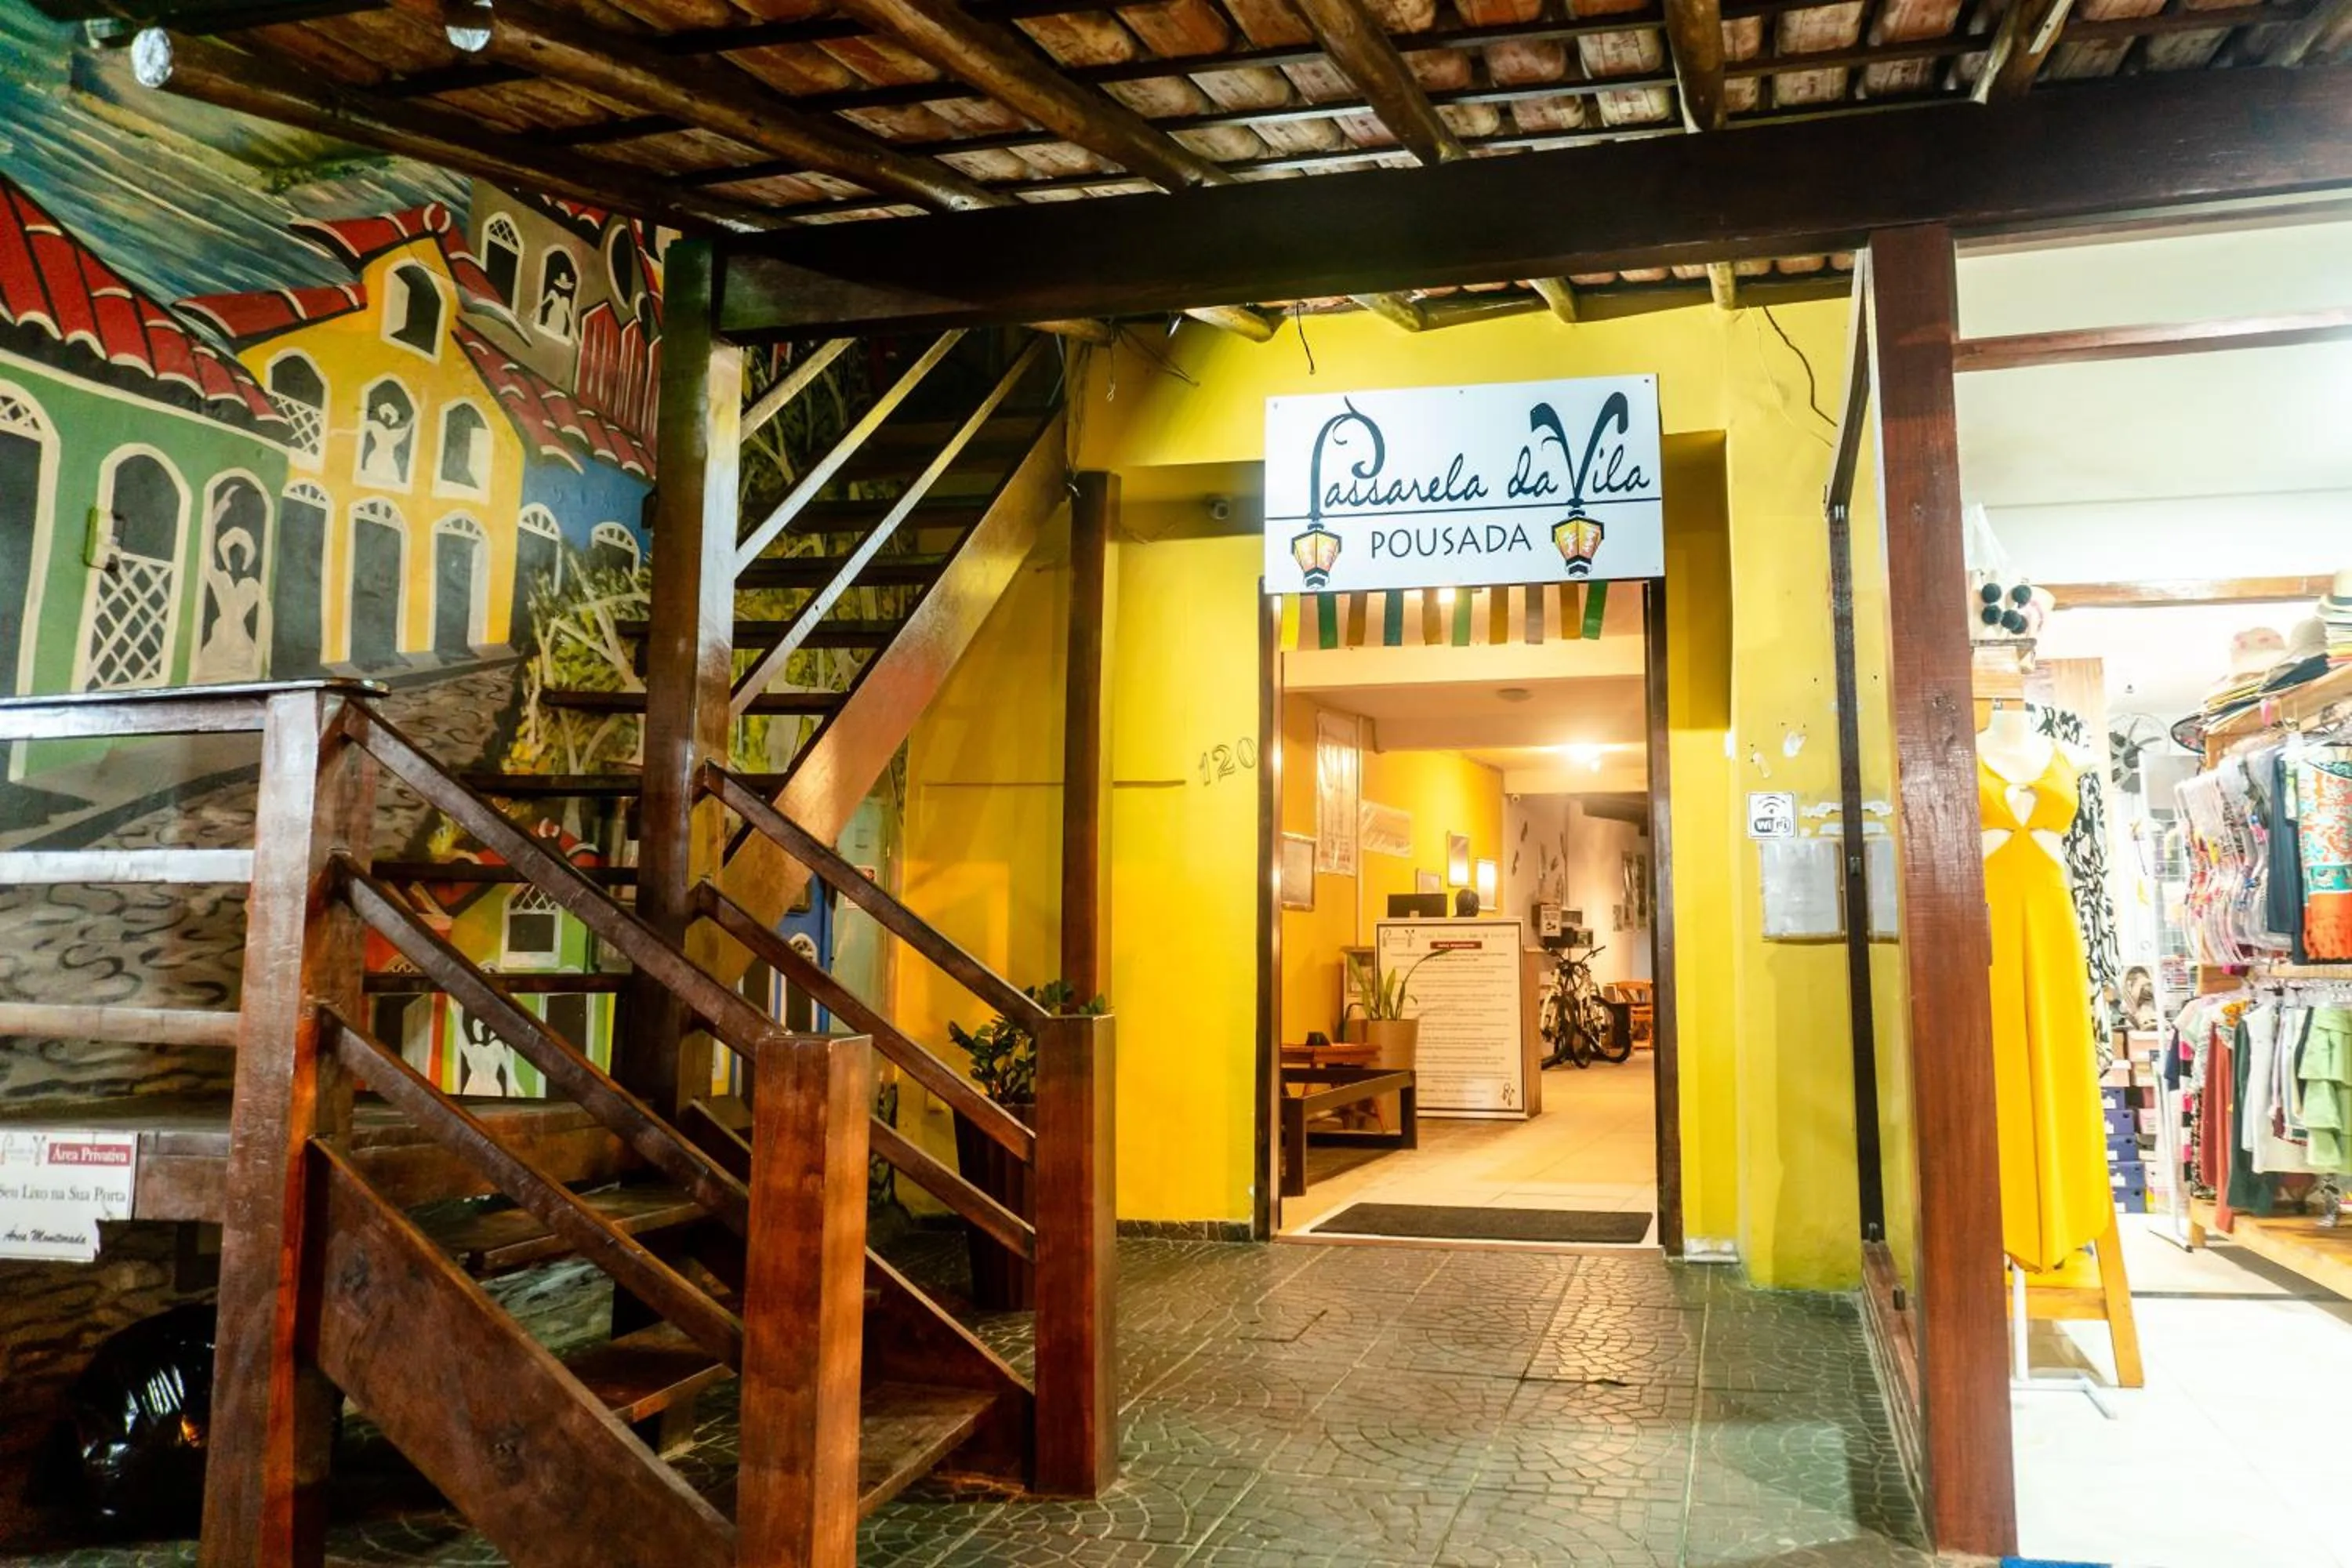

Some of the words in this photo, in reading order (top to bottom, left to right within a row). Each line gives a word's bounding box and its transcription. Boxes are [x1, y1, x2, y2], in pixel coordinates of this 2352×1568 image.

[1310, 396, 1488, 517] Passarela
[1508, 445, 1558, 499] da
[1530, 392, 1650, 504] Vila
[1371, 522, 1533, 560] POUSADA
[1198, 737, 1256, 786] 120
[52, 1142, 78, 1161] Área
[81, 1145, 127, 1163] Privativa
[51, 1189, 64, 1200] na
[67, 1185, 89, 1201] Sua
[94, 1186, 126, 1203] Porta
